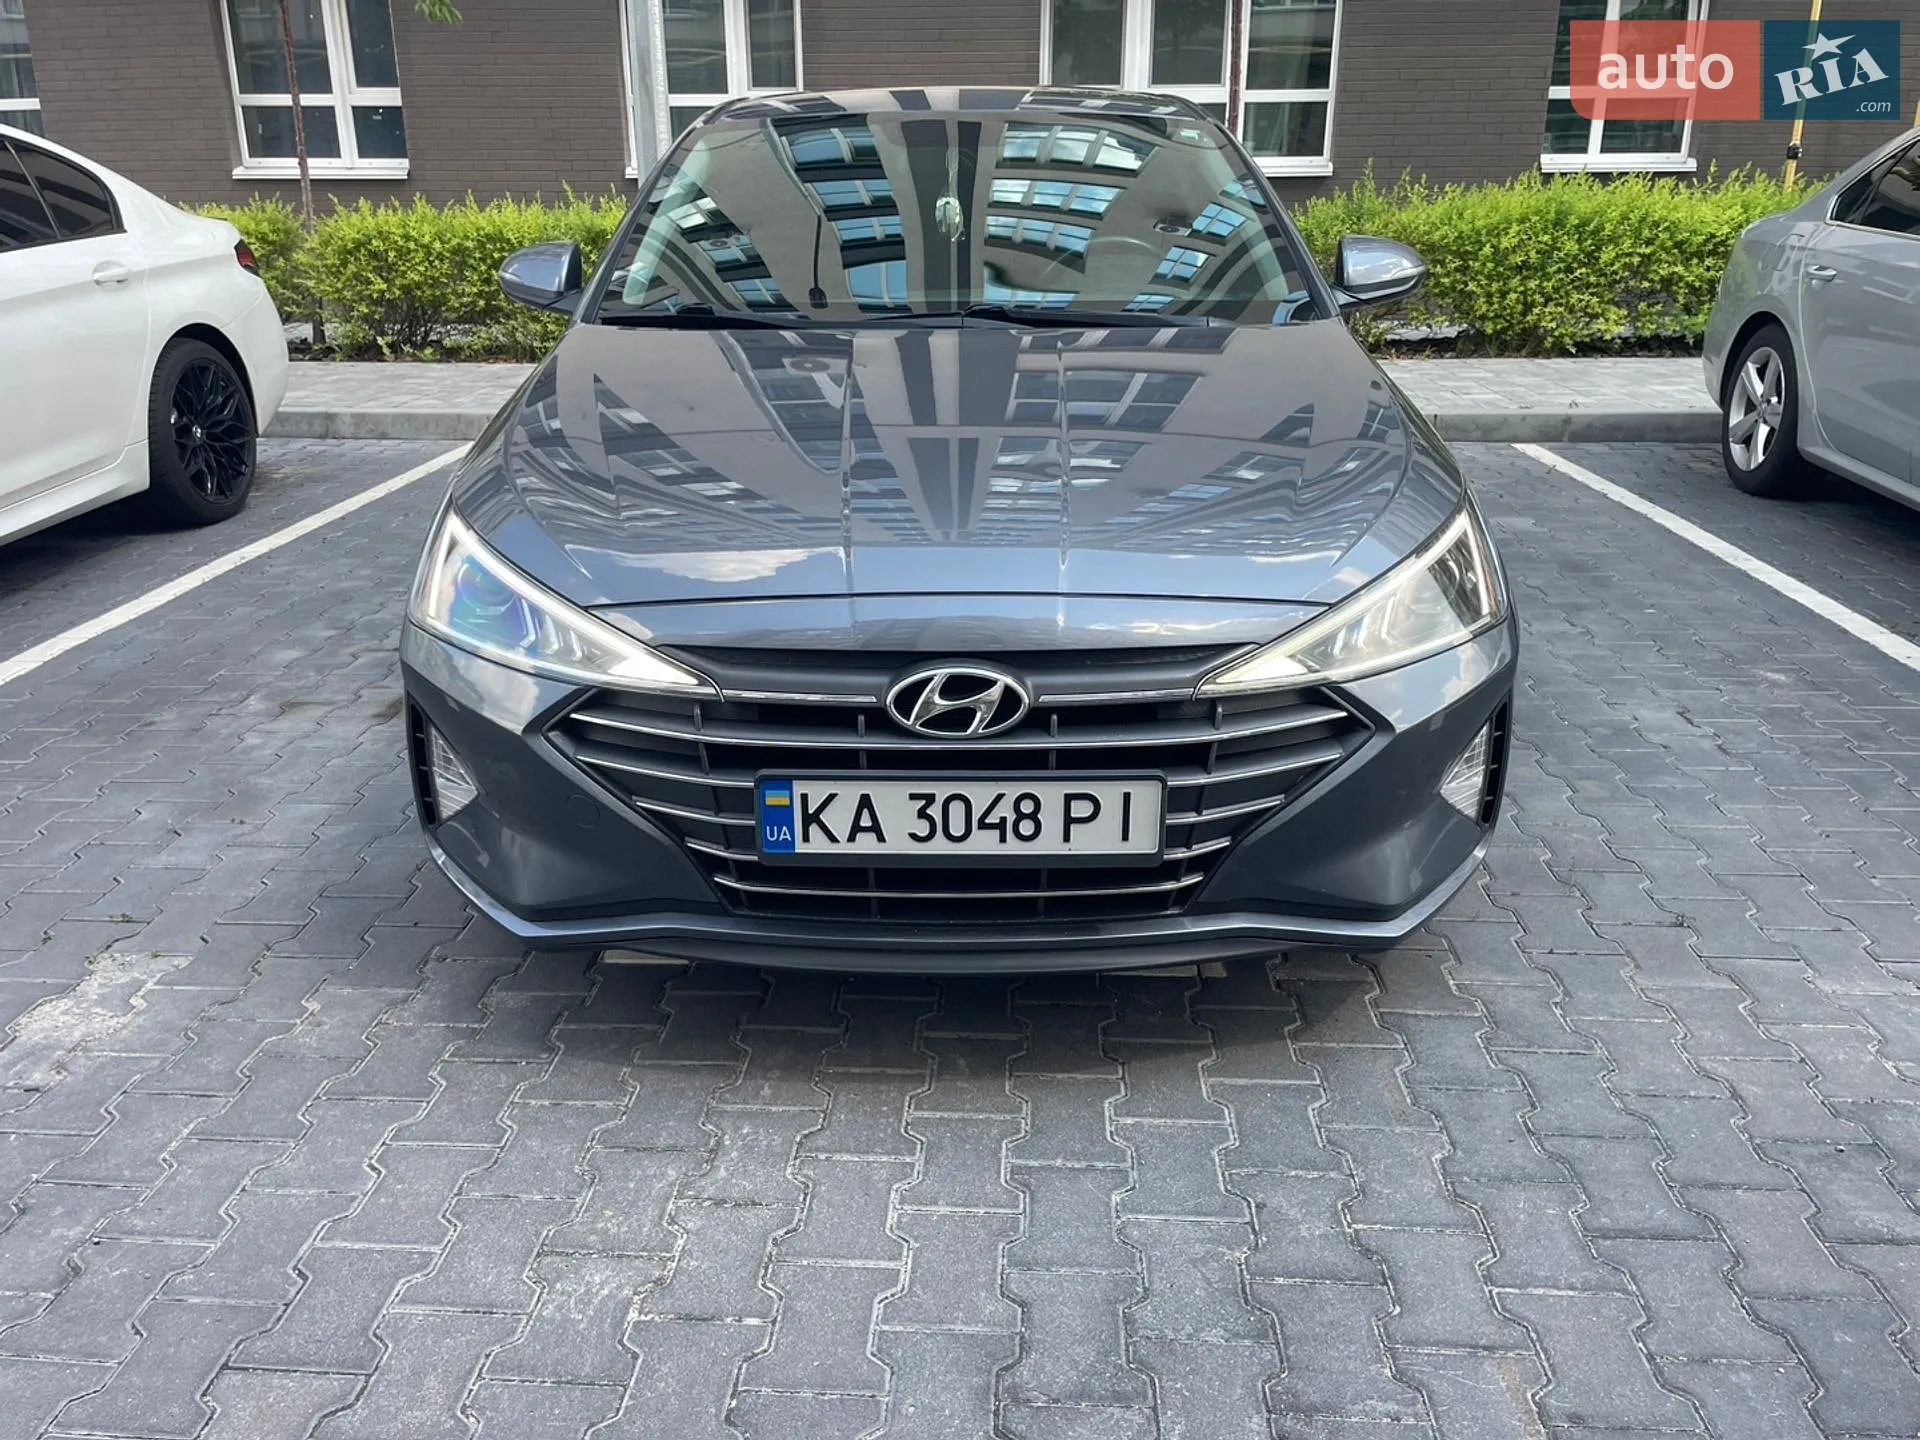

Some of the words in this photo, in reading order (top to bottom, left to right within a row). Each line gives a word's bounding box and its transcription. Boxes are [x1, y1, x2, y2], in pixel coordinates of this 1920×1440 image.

[766, 826, 791, 841] UA
[800, 793, 886, 844] KA
[907, 792, 1043, 843] 3048
